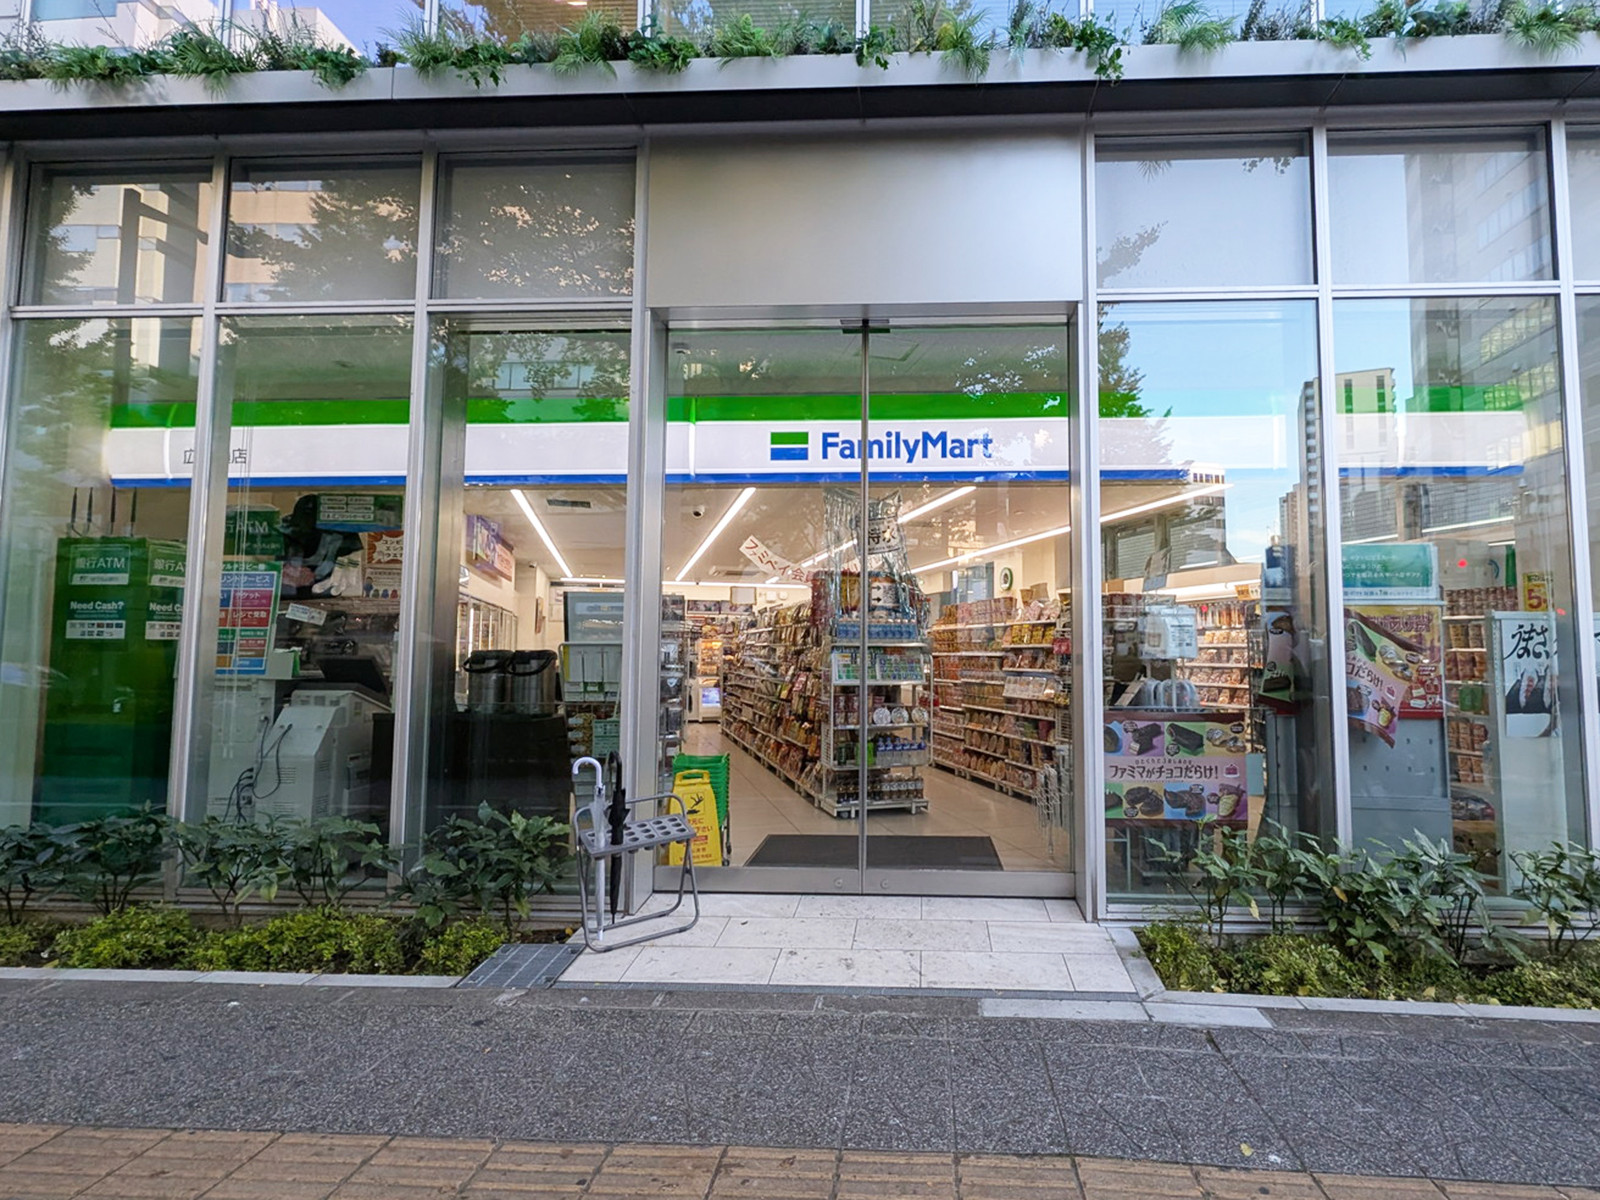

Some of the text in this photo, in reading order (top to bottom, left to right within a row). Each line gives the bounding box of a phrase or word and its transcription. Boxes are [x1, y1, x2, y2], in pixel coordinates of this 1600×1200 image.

[822, 431, 993, 463] FamilyMart
[70, 601, 93, 610] Need
[149, 602, 172, 612] Need
[1109, 764, 1219, 780] ファミマがチョコだらけ!
